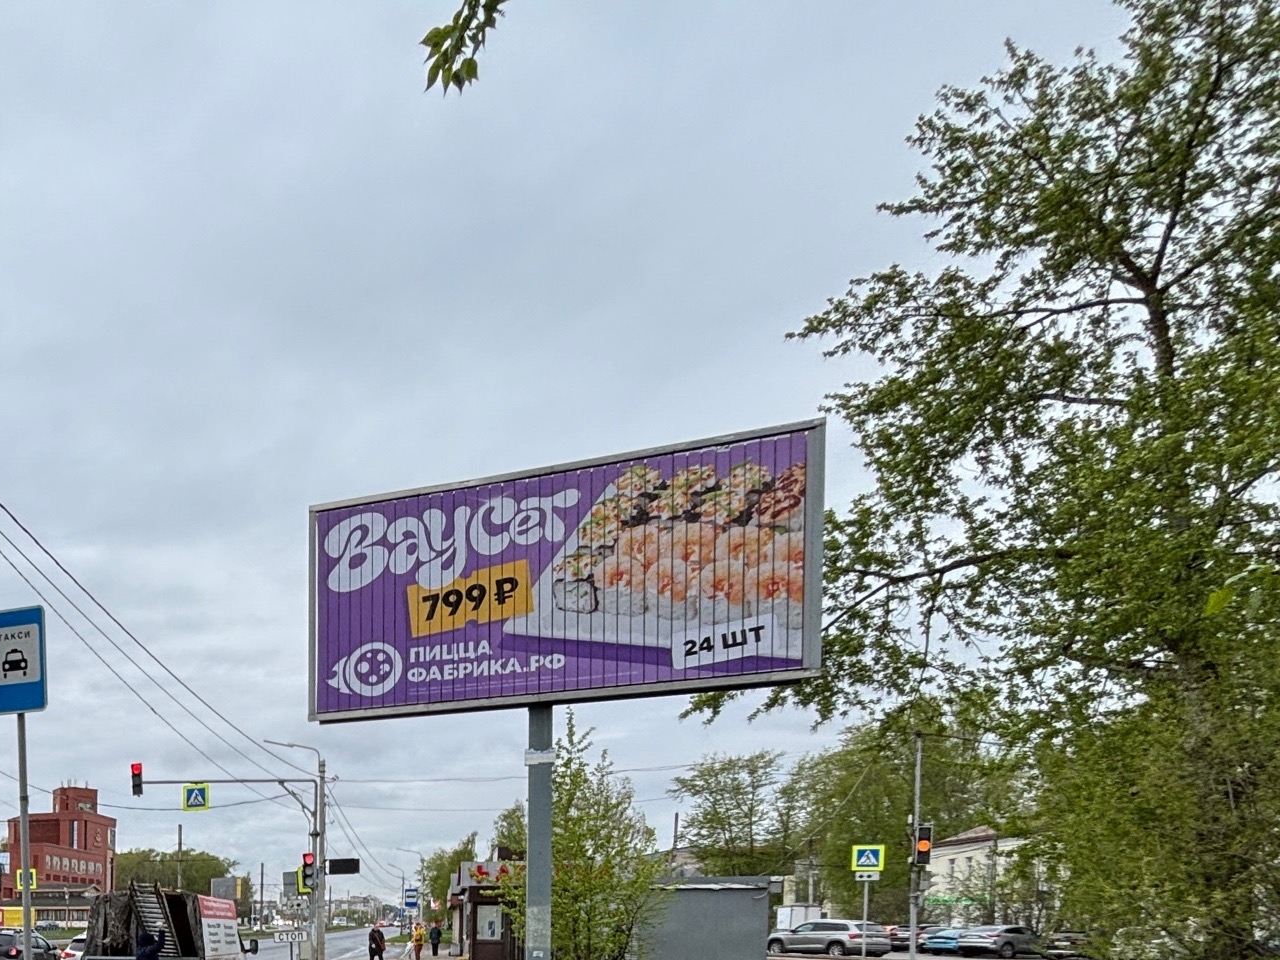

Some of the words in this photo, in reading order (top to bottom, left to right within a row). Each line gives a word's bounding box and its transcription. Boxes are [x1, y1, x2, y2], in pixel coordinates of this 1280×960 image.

[422, 583, 487, 621] 799
[409, 639, 493, 663] ПИЦЦА
[683, 636, 715, 657] 24
[721, 625, 765, 649] ШТ
[407, 653, 566, 683] ФАБРИКА.РФ
[278, 931, 304, 941] СТОП
